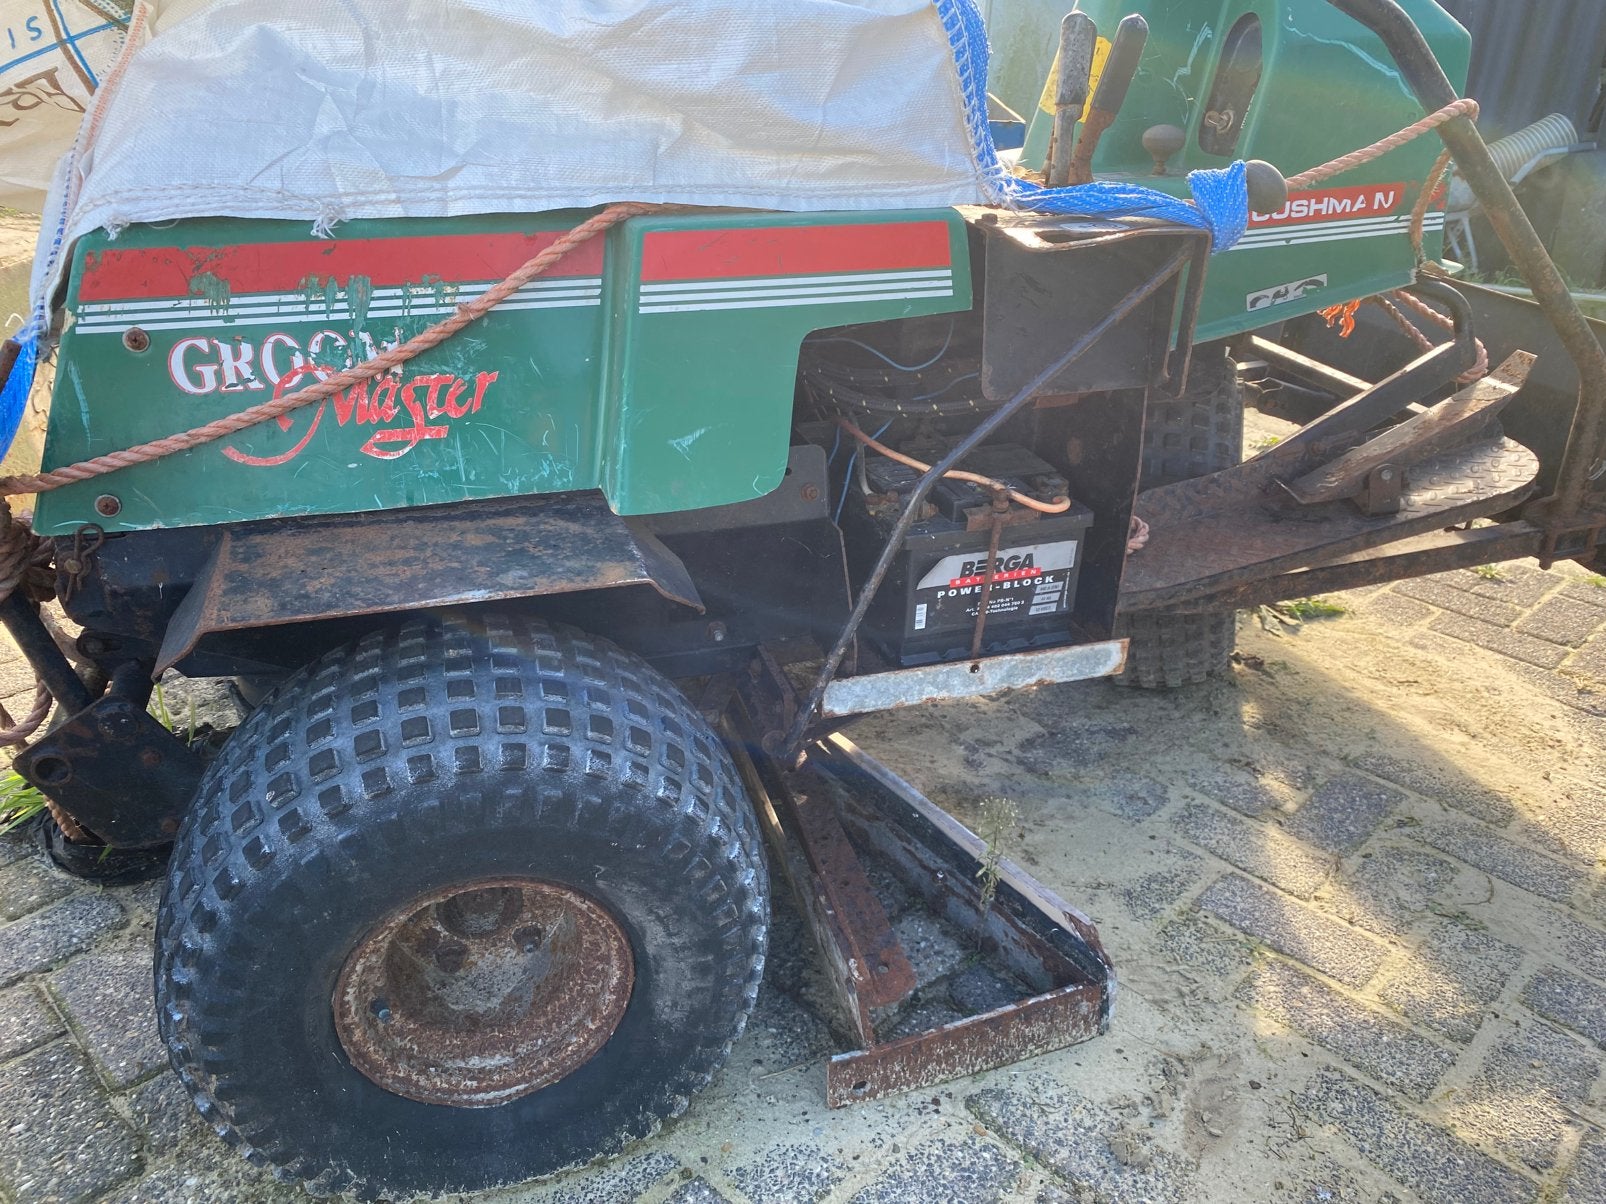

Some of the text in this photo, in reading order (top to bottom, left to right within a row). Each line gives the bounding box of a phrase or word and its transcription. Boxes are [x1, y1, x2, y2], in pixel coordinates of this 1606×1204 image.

[1251, 191, 1395, 222] USHMAN
[955, 569, 1038, 585] BATERIEN
[960, 552, 1035, 578] BERGA
